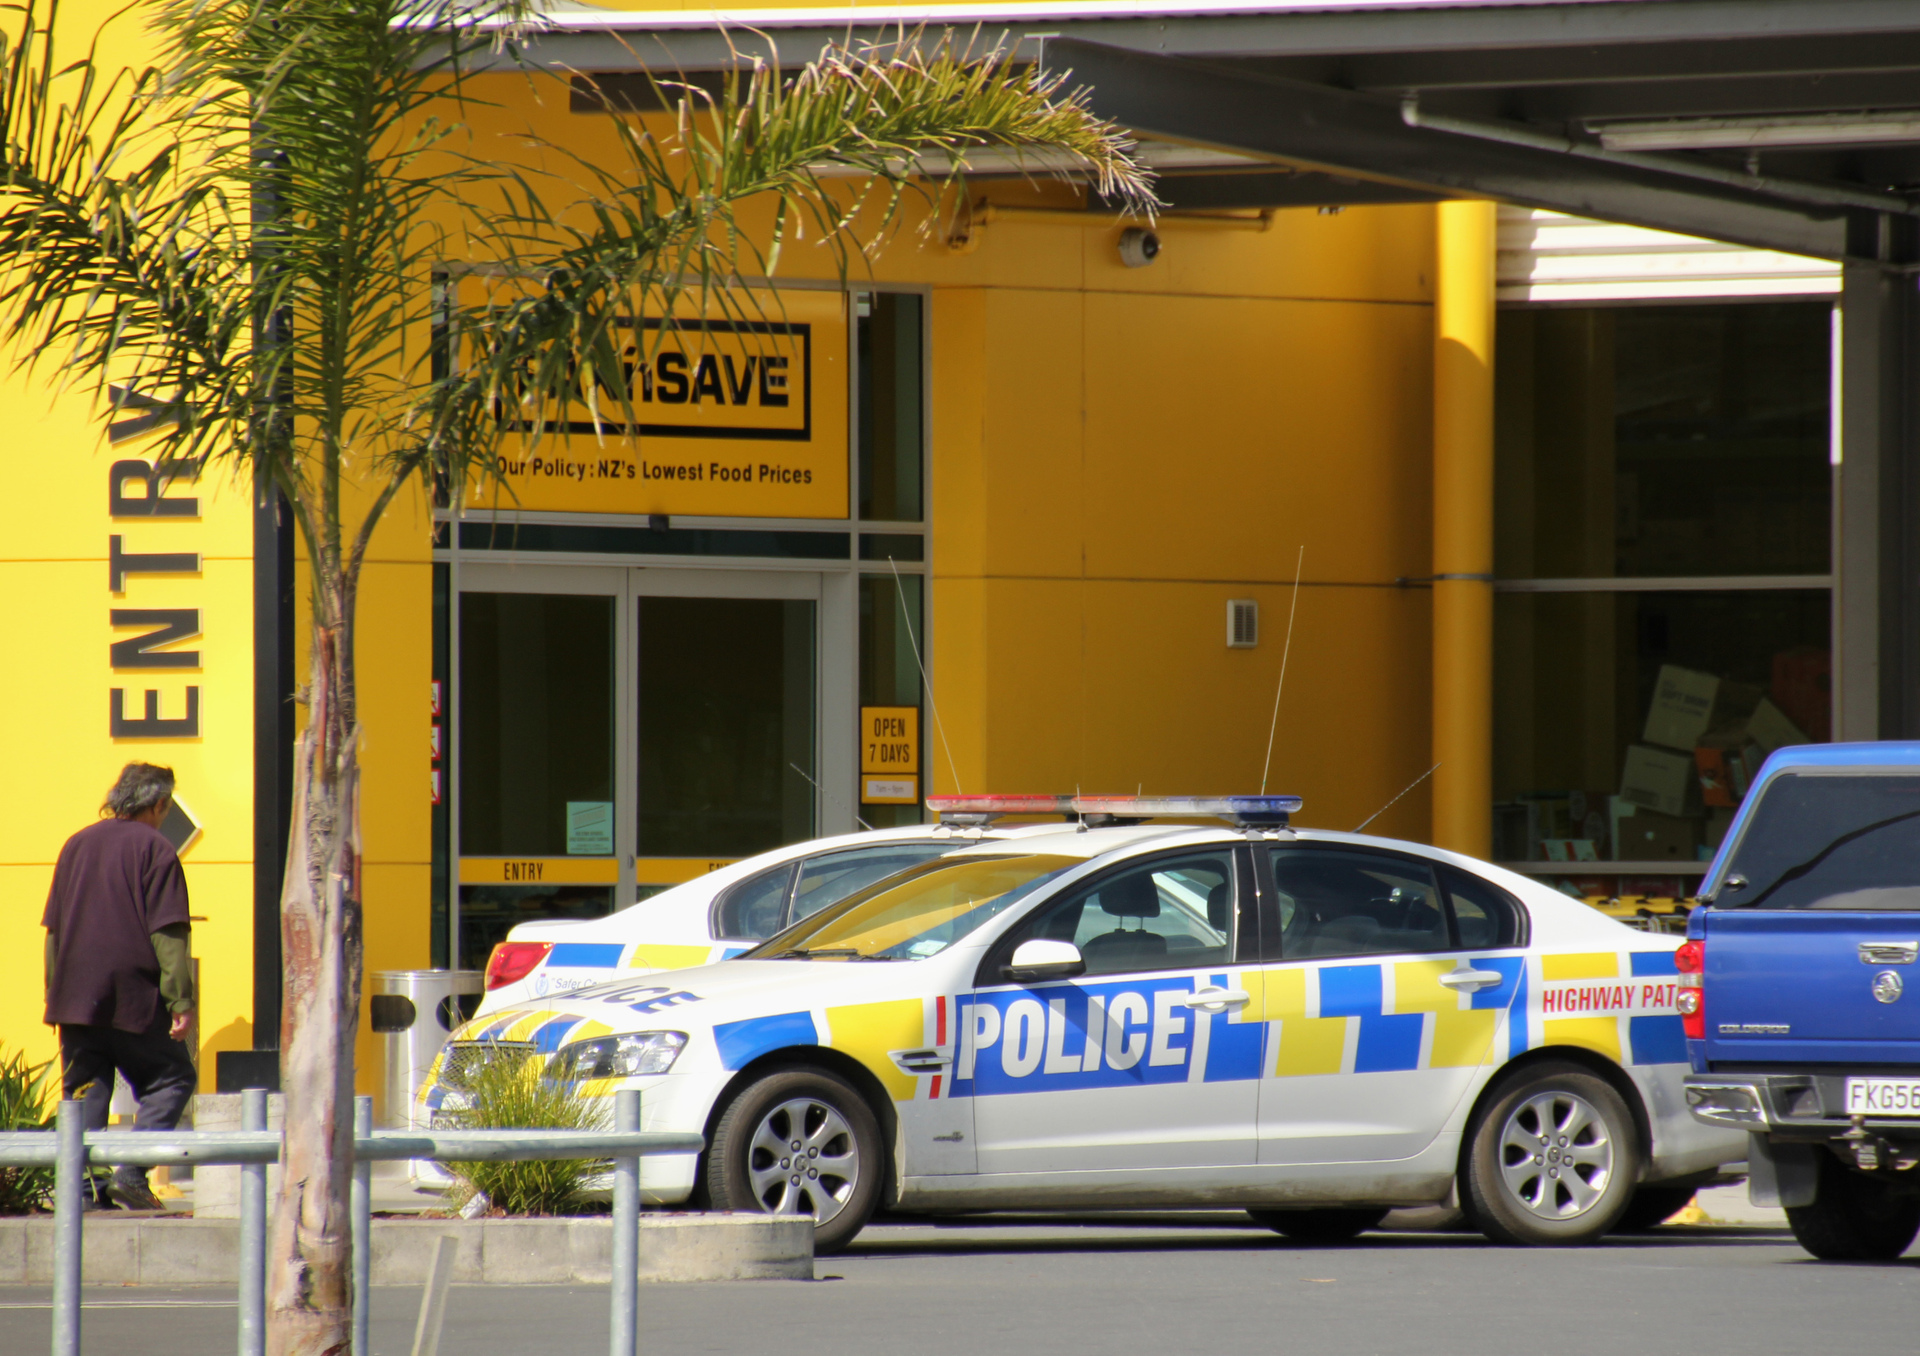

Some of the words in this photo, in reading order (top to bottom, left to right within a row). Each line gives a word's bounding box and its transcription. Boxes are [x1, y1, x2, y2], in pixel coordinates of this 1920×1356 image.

[497, 456, 526, 476] Our
[598, 459, 636, 479] NZ's
[642, 460, 704, 481] Lowest
[710, 463, 752, 482] Food
[759, 464, 813, 484] Prices
[108, 383, 203, 738] ENTRY
[874, 718, 905, 738] OPEN
[869, 743, 877, 763] 7
[881, 743, 910, 763] DAYS
[504, 862, 544, 881] ENTRY
[1542, 985, 1636, 1014] HIGHWAY
[956, 989, 1190, 1080] POLICE
[1717, 1023, 1791, 1034] COLORADO
